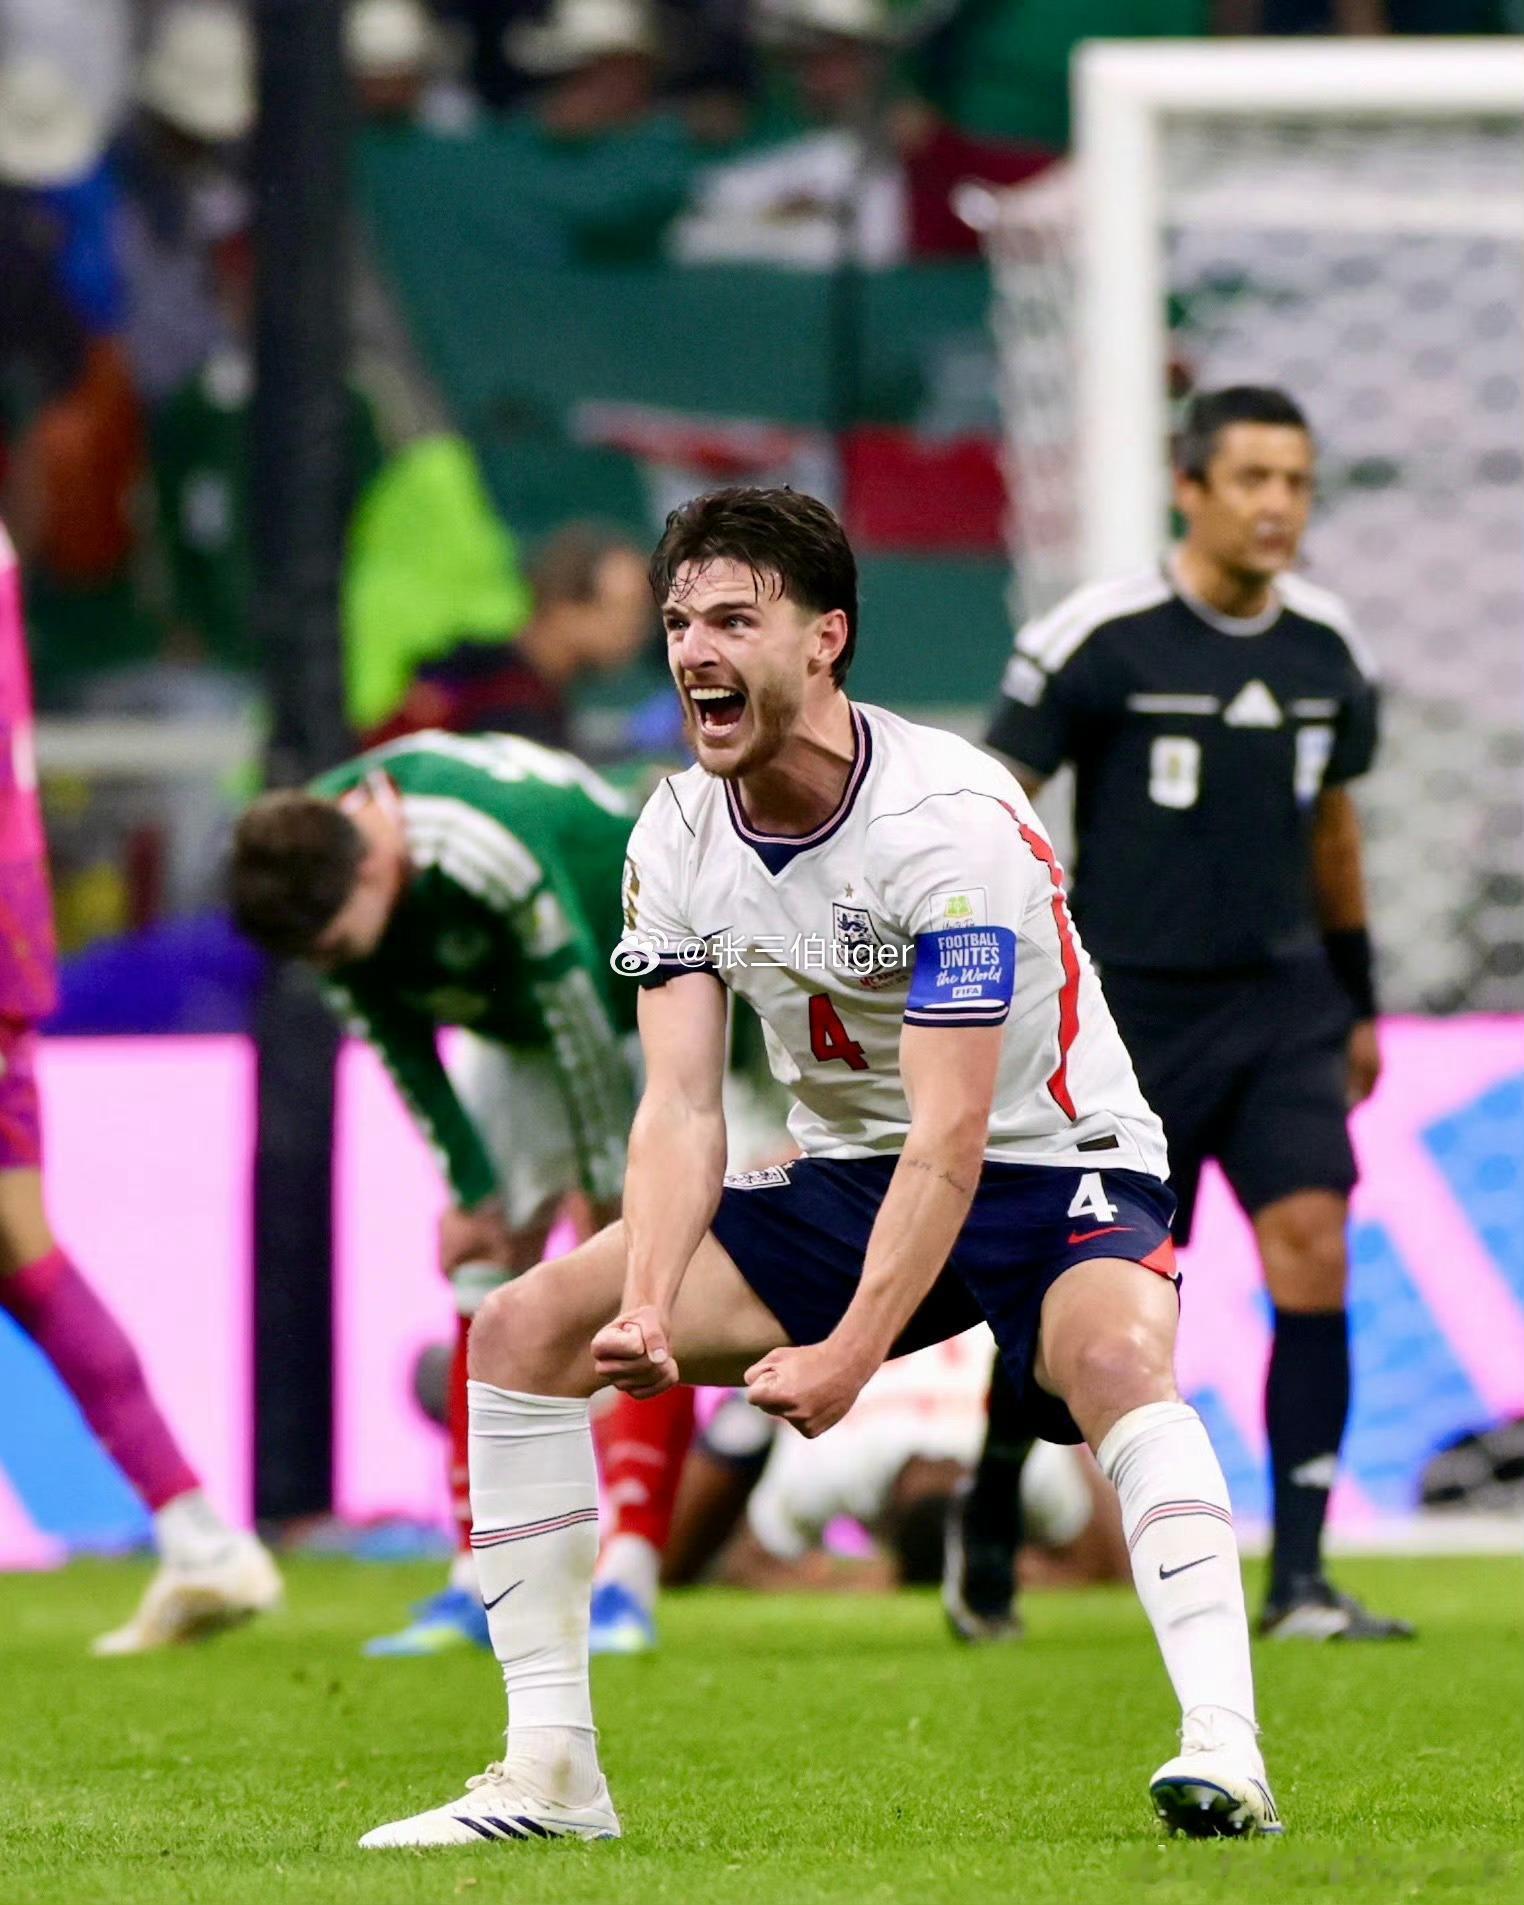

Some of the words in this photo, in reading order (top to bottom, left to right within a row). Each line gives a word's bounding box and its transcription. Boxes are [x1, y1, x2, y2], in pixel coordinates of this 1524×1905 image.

[938, 932, 999, 951] FOOTBALL
[940, 947, 1000, 969] UNITES
[936, 969, 959, 987] the
[961, 966, 1002, 983] World
[954, 987, 980, 996] FIFA
[809, 994, 869, 1070] 4
[1067, 1171, 1119, 1222] 4
